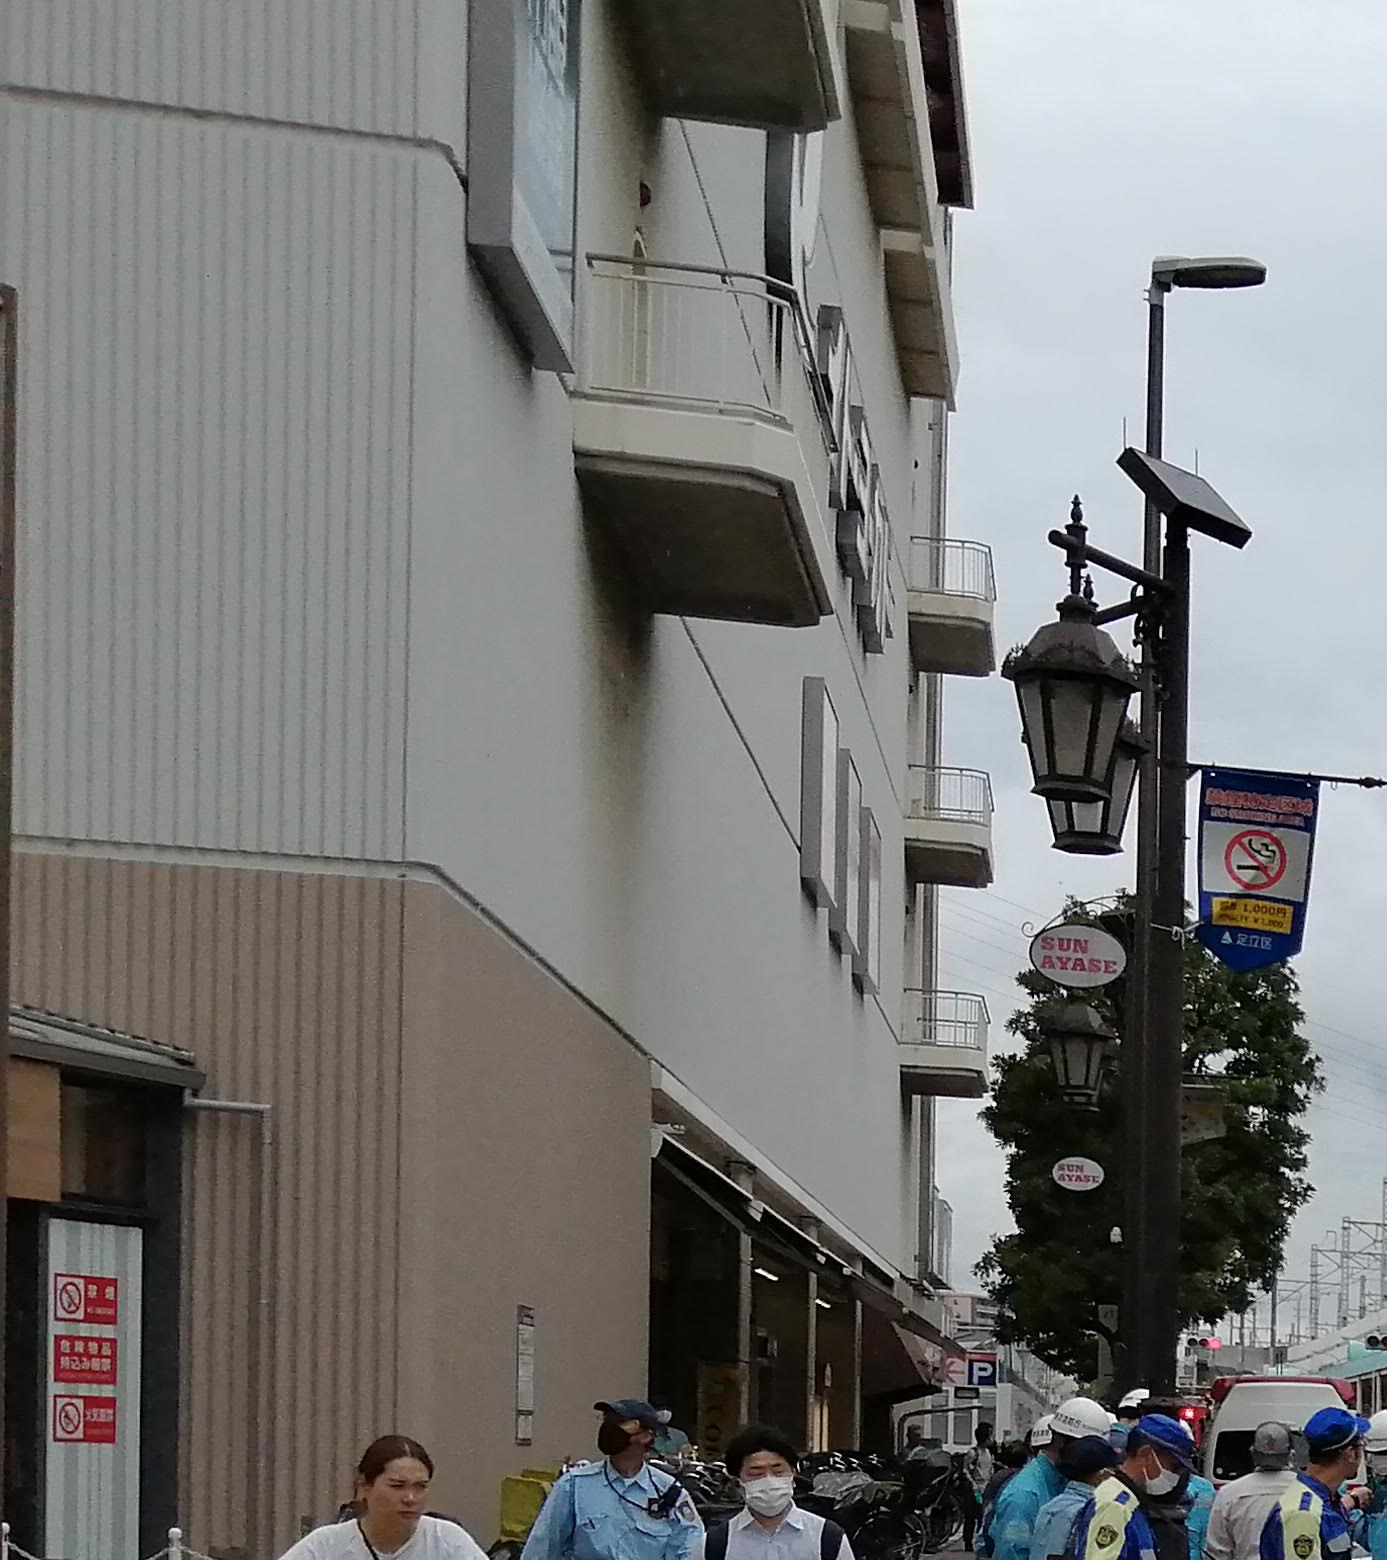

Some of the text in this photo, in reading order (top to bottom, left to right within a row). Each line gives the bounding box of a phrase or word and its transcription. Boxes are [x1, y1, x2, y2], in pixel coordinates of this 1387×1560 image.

[1041, 936, 1088, 954] SUN
[1040, 955, 1117, 974] AYASE
[1058, 1163, 1084, 1173] SUN
[1057, 1173, 1100, 1183] AYASE
[972, 1361, 993, 1385] P
